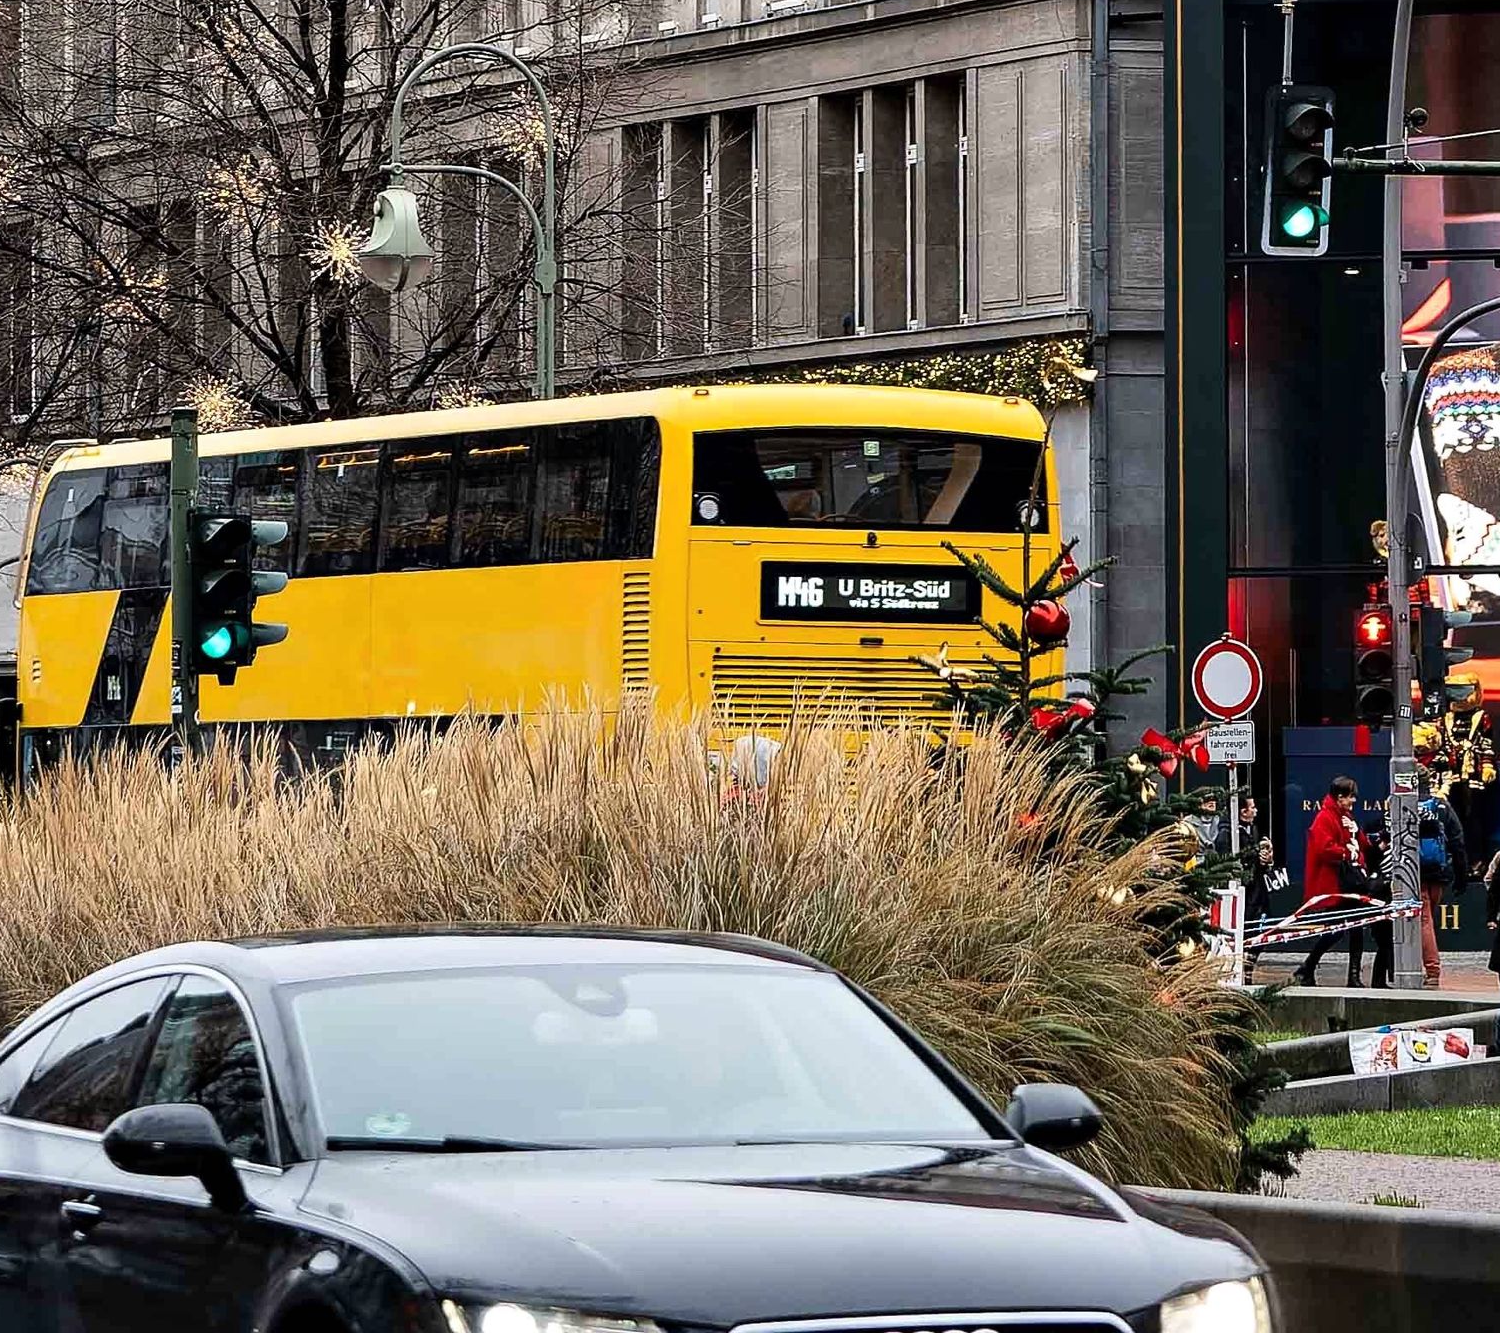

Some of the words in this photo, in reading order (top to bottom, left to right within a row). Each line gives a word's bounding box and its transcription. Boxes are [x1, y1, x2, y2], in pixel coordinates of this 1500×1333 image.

[839, 579, 854, 595] U
[860, 579, 950, 598] Britz-Süd
[849, 598, 869, 608] via
[882, 598, 939, 609] Südkreuz
